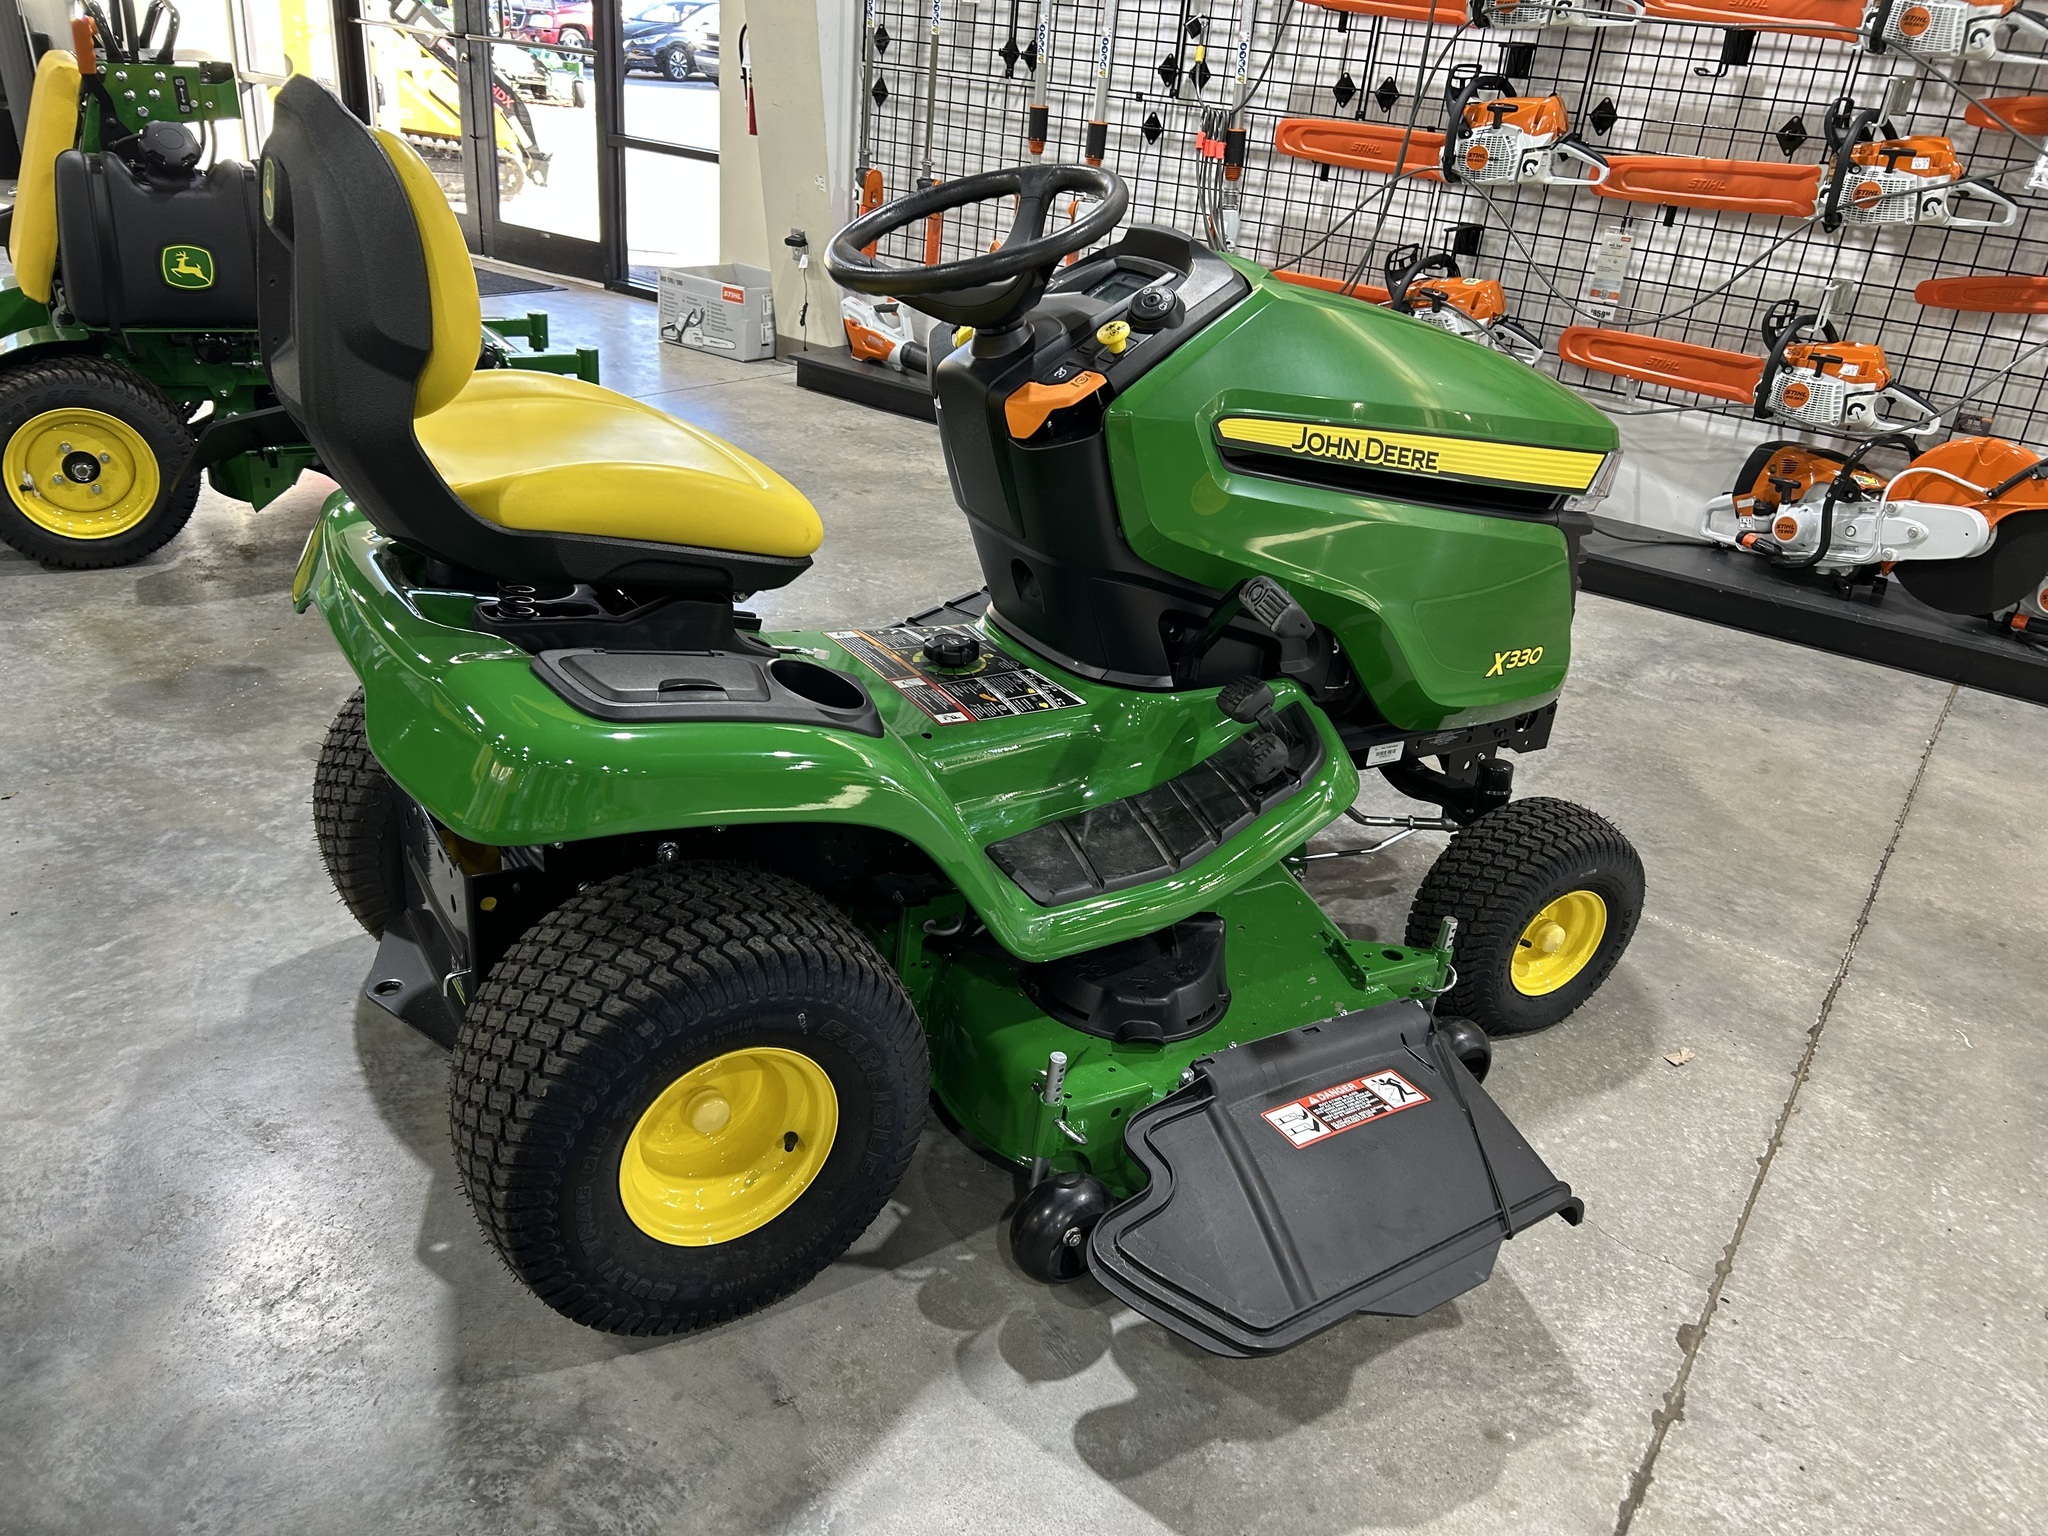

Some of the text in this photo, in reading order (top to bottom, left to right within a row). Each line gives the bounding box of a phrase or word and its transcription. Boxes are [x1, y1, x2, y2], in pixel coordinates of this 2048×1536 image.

[1903, 14, 1929, 23] STIHL
[1351, 142, 1381, 155] STIHL
[1688, 177, 1726, 192] STIHL
[1854, 188, 1880, 197] STIHL
[723, 290, 743, 300] STIHL
[1645, 355, 1680, 371] STIHL
[1785, 389, 1808, 398] STIHL
[1292, 427, 1439, 471] JOHN DEERE
[1485, 646, 1544, 677] X330
[817, 1019, 895, 1177] CARLISLE
[1318, 1083, 1358, 1102] DANGER
